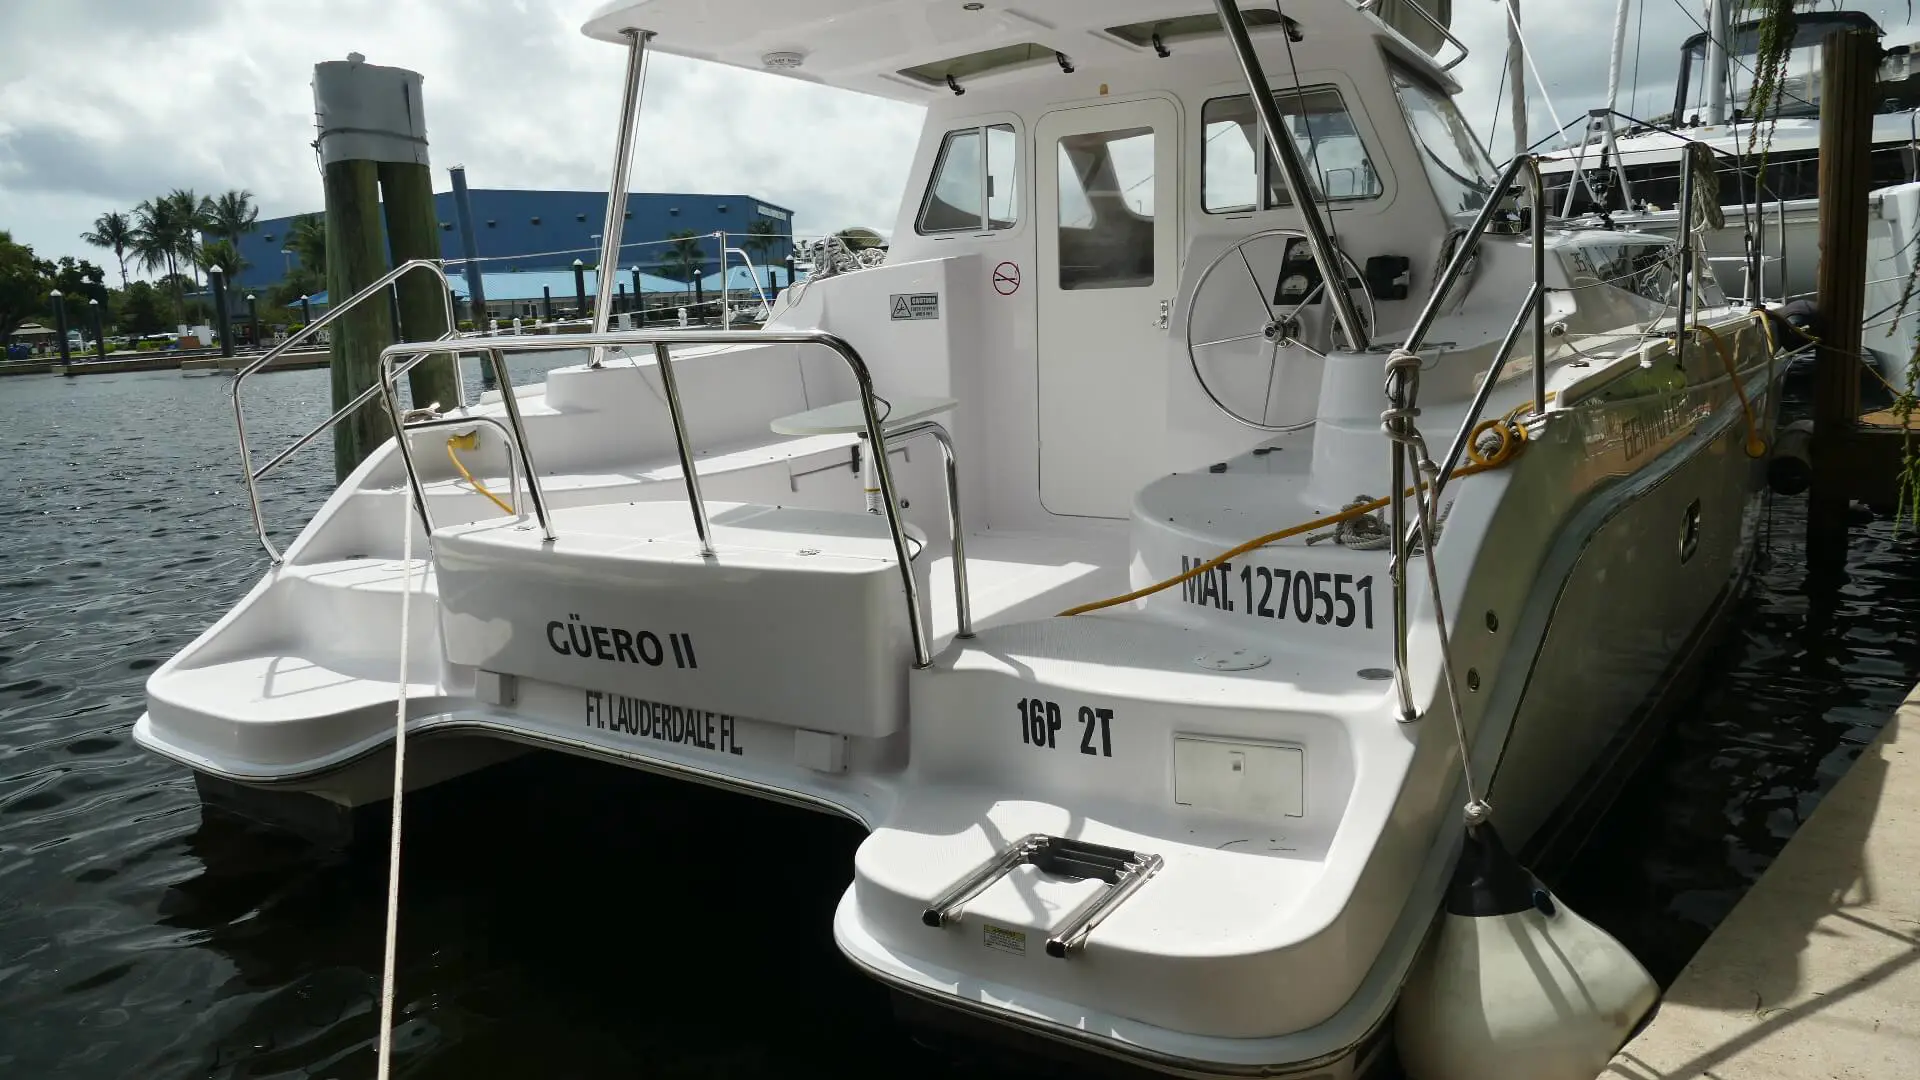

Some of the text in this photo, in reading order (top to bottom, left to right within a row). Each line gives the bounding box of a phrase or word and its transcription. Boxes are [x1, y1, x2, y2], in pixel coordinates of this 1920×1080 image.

[1182, 555, 1373, 629] MAT. 1270551
[546, 613, 698, 669] GÜERO II
[586, 690, 605, 729] FT.
[608, 692, 716, 751] LAUDERDALE
[1017, 697, 1114, 757] 16P 2T
